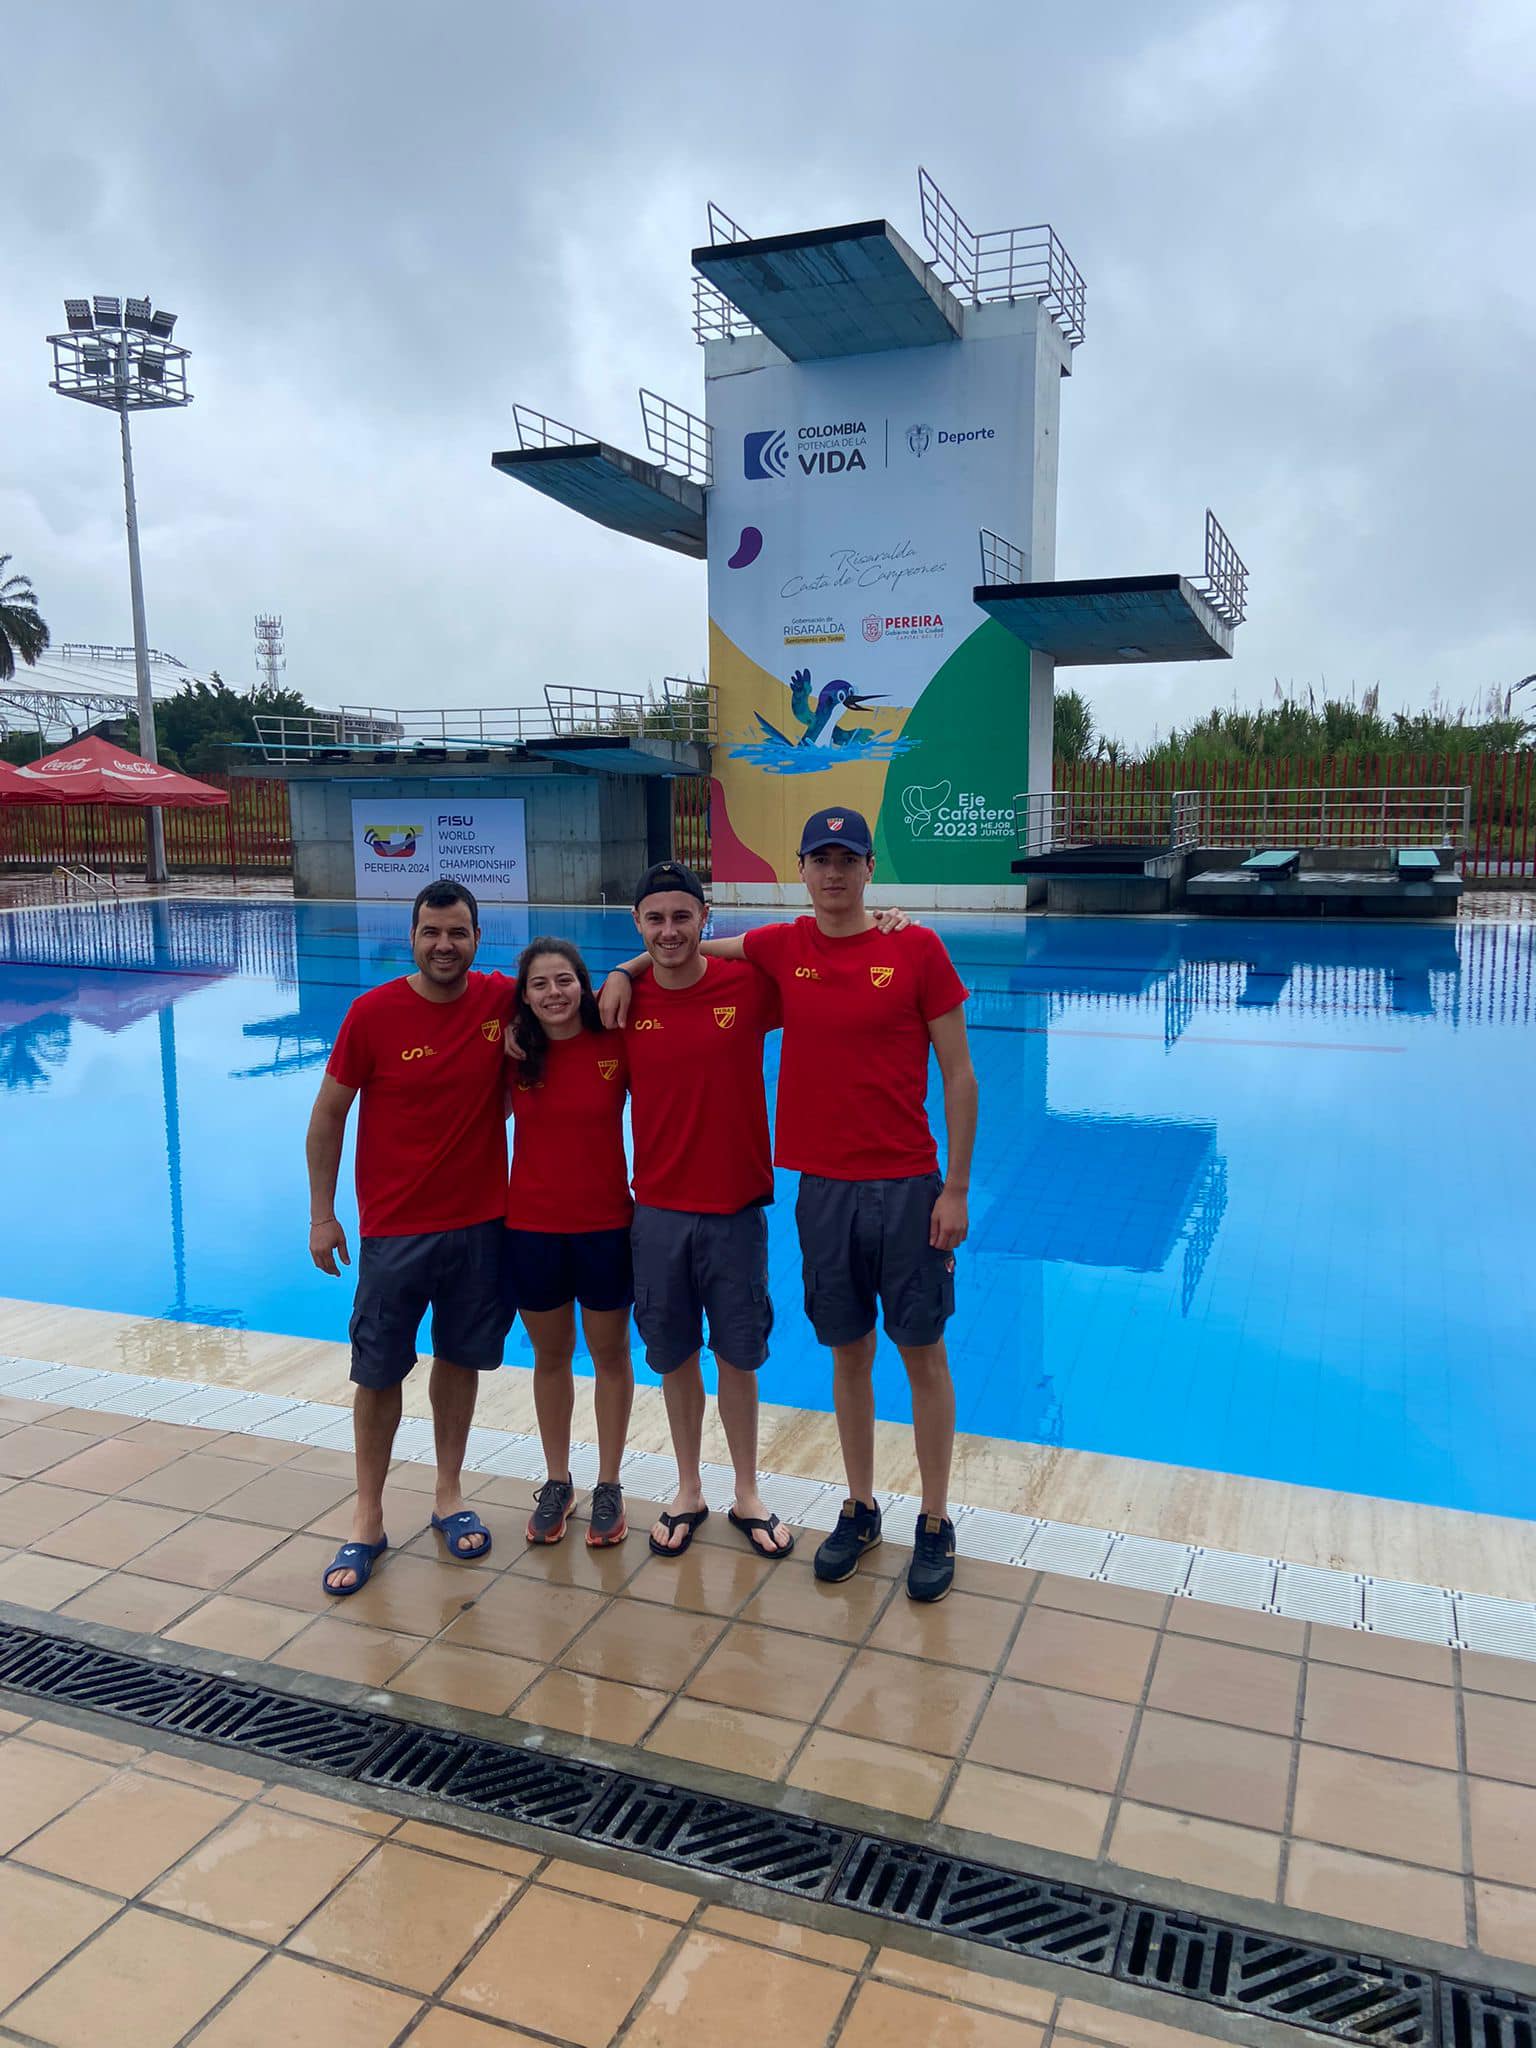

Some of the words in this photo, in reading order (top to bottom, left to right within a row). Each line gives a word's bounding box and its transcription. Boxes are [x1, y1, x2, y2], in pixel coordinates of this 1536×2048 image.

[798, 421, 867, 440] COLOMBIA
[938, 427, 995, 444] Deporte
[798, 439, 841, 450] POTENCIA
[842, 438, 854, 448] DE
[855, 437, 867, 446] LA
[798, 449, 867, 475] VIDA
[830, 540, 916, 572] Risaralda
[780, 573, 829, 598] Casta
[834, 569, 851, 587] de
[857, 562, 948, 591] Campeones
[885, 614, 943, 629] PEREIRA
[959, 793, 985, 809] Eje
[438, 815, 474, 826] FISU
[938, 807, 1015, 821] Cafetero
[438, 831, 475, 840] WORLD
[933, 823, 977, 836] 2023
[439, 845, 495, 855] UNIVERSITY
[364, 863, 406, 873] PEREIRA
[408, 863, 430, 873] 2024
[439, 859, 516, 869] CHAMPIONSHIP
[439, 873, 511, 884] FINSWIMMING
